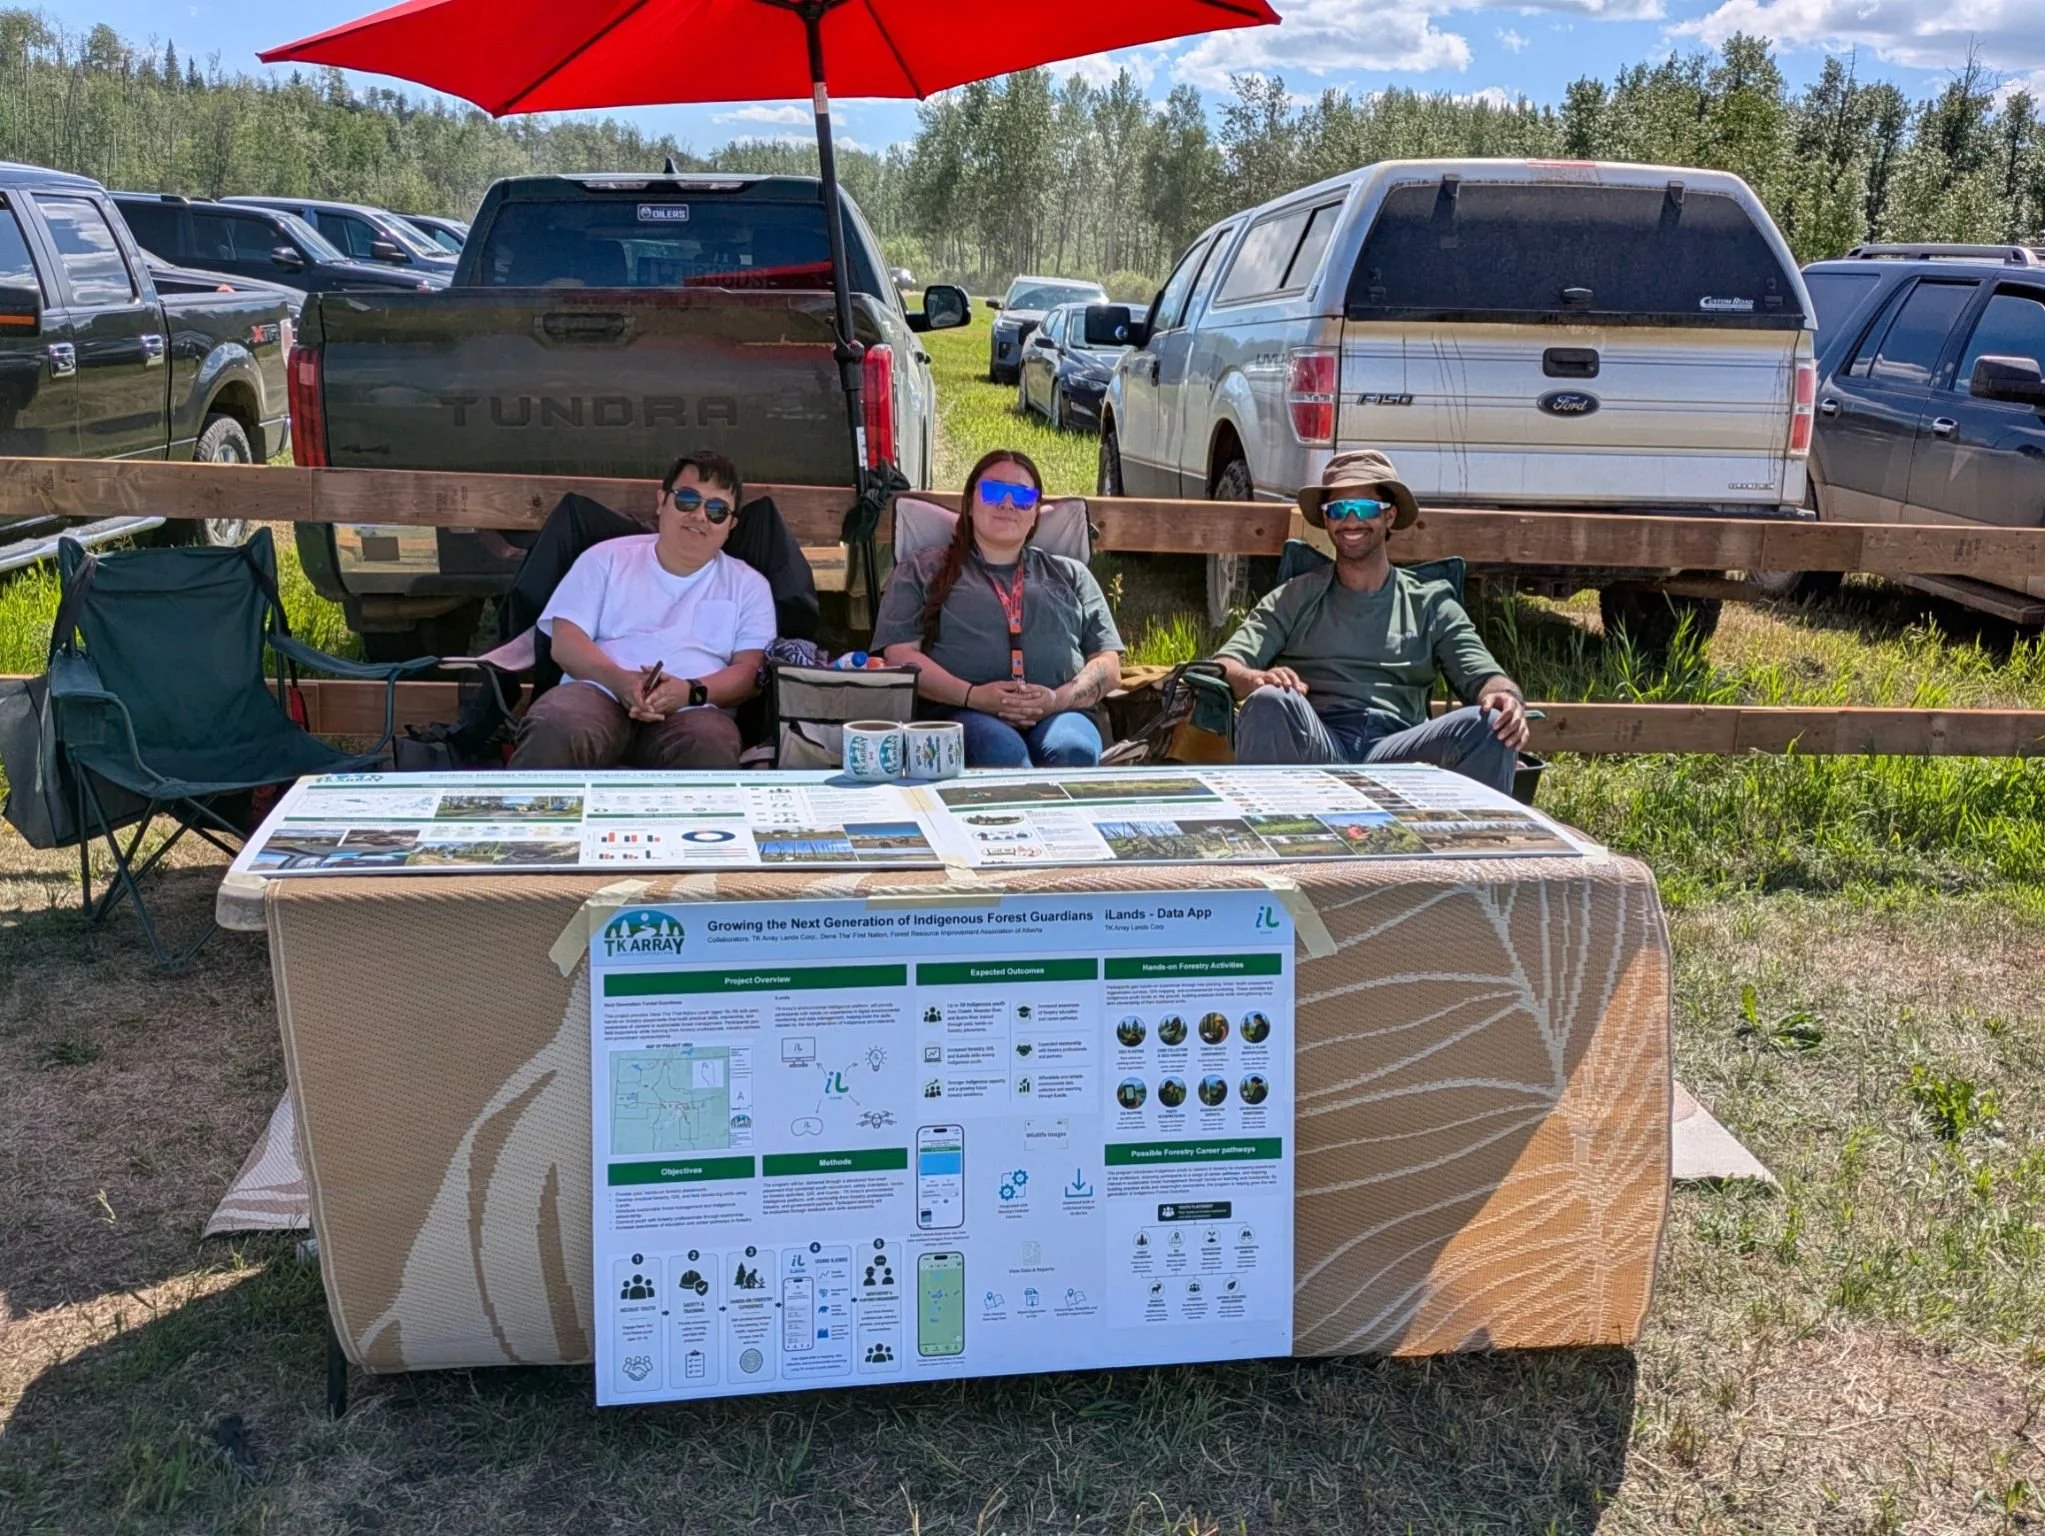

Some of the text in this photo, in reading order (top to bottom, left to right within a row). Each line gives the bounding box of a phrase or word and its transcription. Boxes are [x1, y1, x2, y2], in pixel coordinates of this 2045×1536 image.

[652, 210, 686, 218] OILERS
[1553, 395, 1588, 410] Ford
[439, 395, 737, 428] TUNDRA
[1105, 908, 1146, 920] iLands
[1157, 907, 1186, 919] Data
[1188, 907, 1212, 920] App
[707, 909, 1094, 934] Growing the Next Generation of Indigenous Forest Guardians
[604, 938, 685, 957] TK ARRAY
[970, 967, 1045, 977] Expected Outcomes
[1142, 961, 1244, 971] Hands-on Forestry Activities
[724, 975, 791, 986] Project Overview
[1131, 1145, 1256, 1158] Possible Forestry Career pathways
[819, 1158, 852, 1167] Methods
[660, 1167, 703, 1177] Objectives
